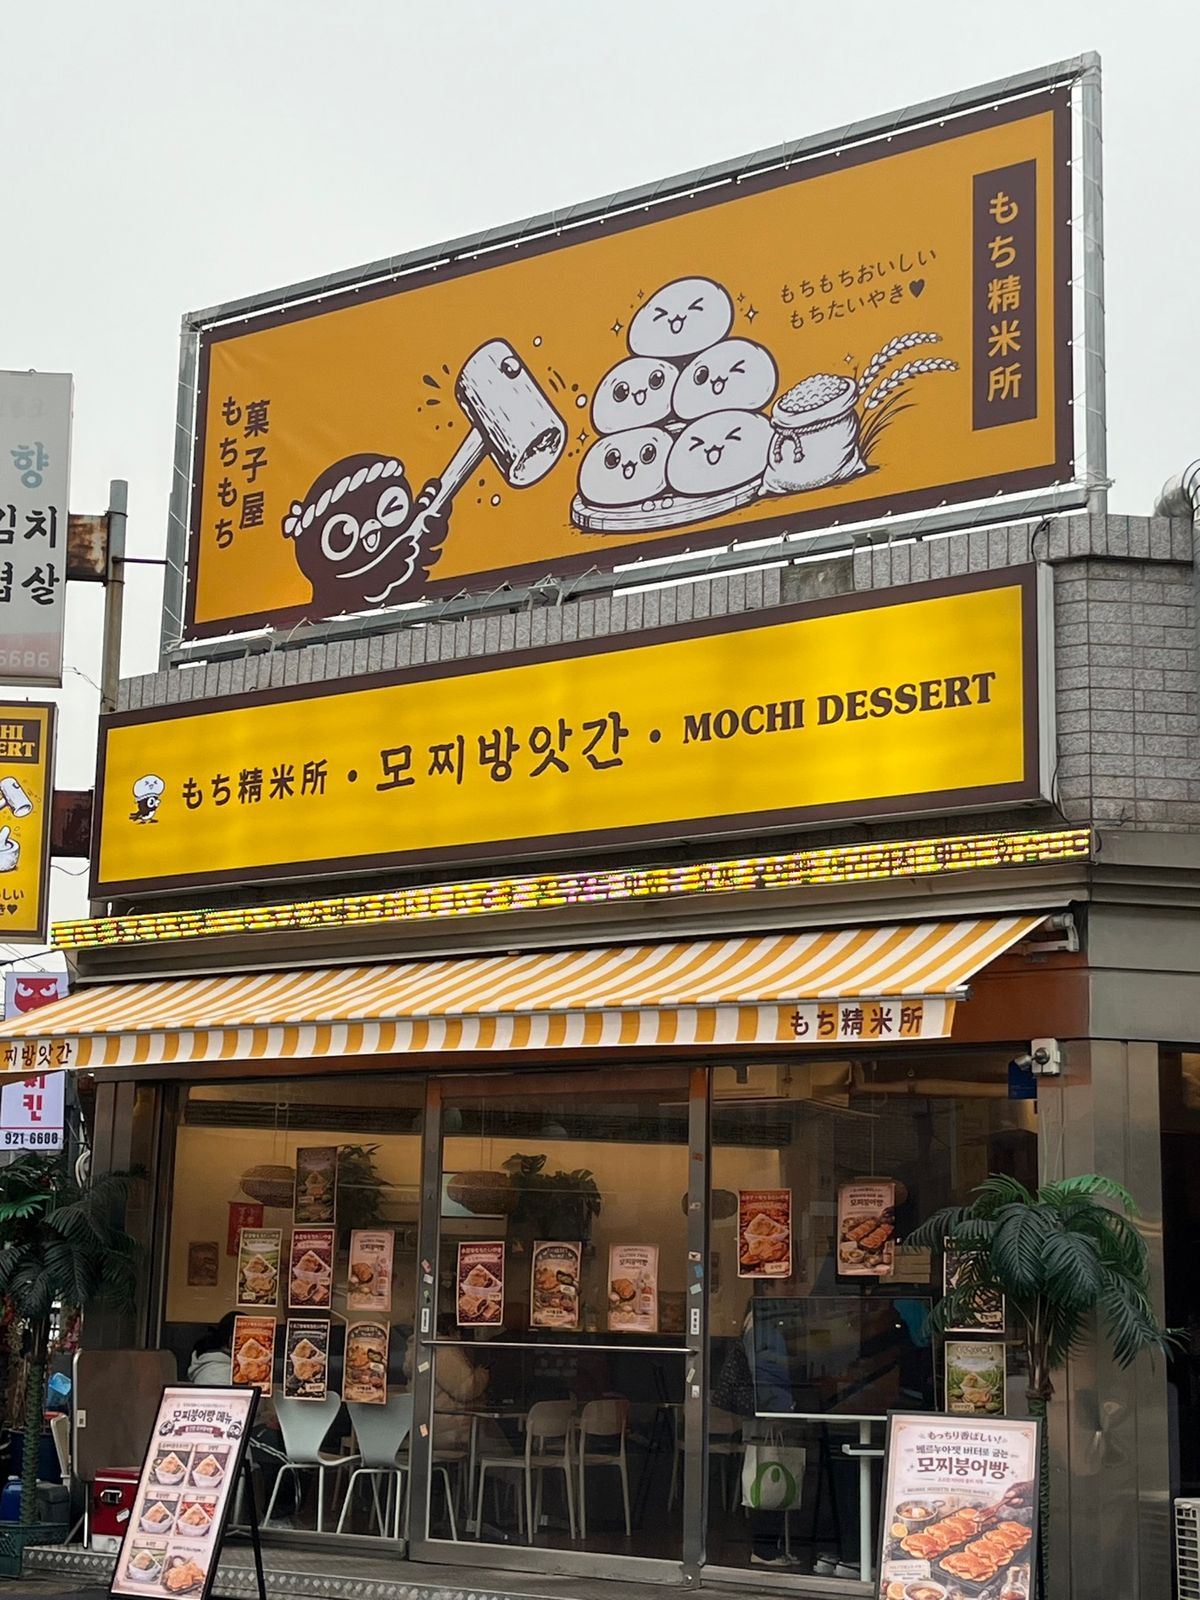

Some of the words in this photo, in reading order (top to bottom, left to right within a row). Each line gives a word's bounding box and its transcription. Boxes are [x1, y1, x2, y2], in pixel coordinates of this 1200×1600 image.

[781, 249, 937, 304] もちもちおいしい
[988, 191, 1022, 402] もち精米所
[789, 283, 905, 330] もちたいやき
[10, 441, 50, 489] 향
[214, 395, 242, 549] もちもち
[238, 399, 271, 530] 菓子屋
[683, 699, 805, 744] MOCHI
[816, 671, 997, 726] DESSERT
[375, 711, 630, 793] 모찌방앗간
[181, 758, 328, 810] もち精米所
[790, 1005, 923, 1036] もち精米所
[917, 1457, 1010, 1480] 모찌붕어빵
